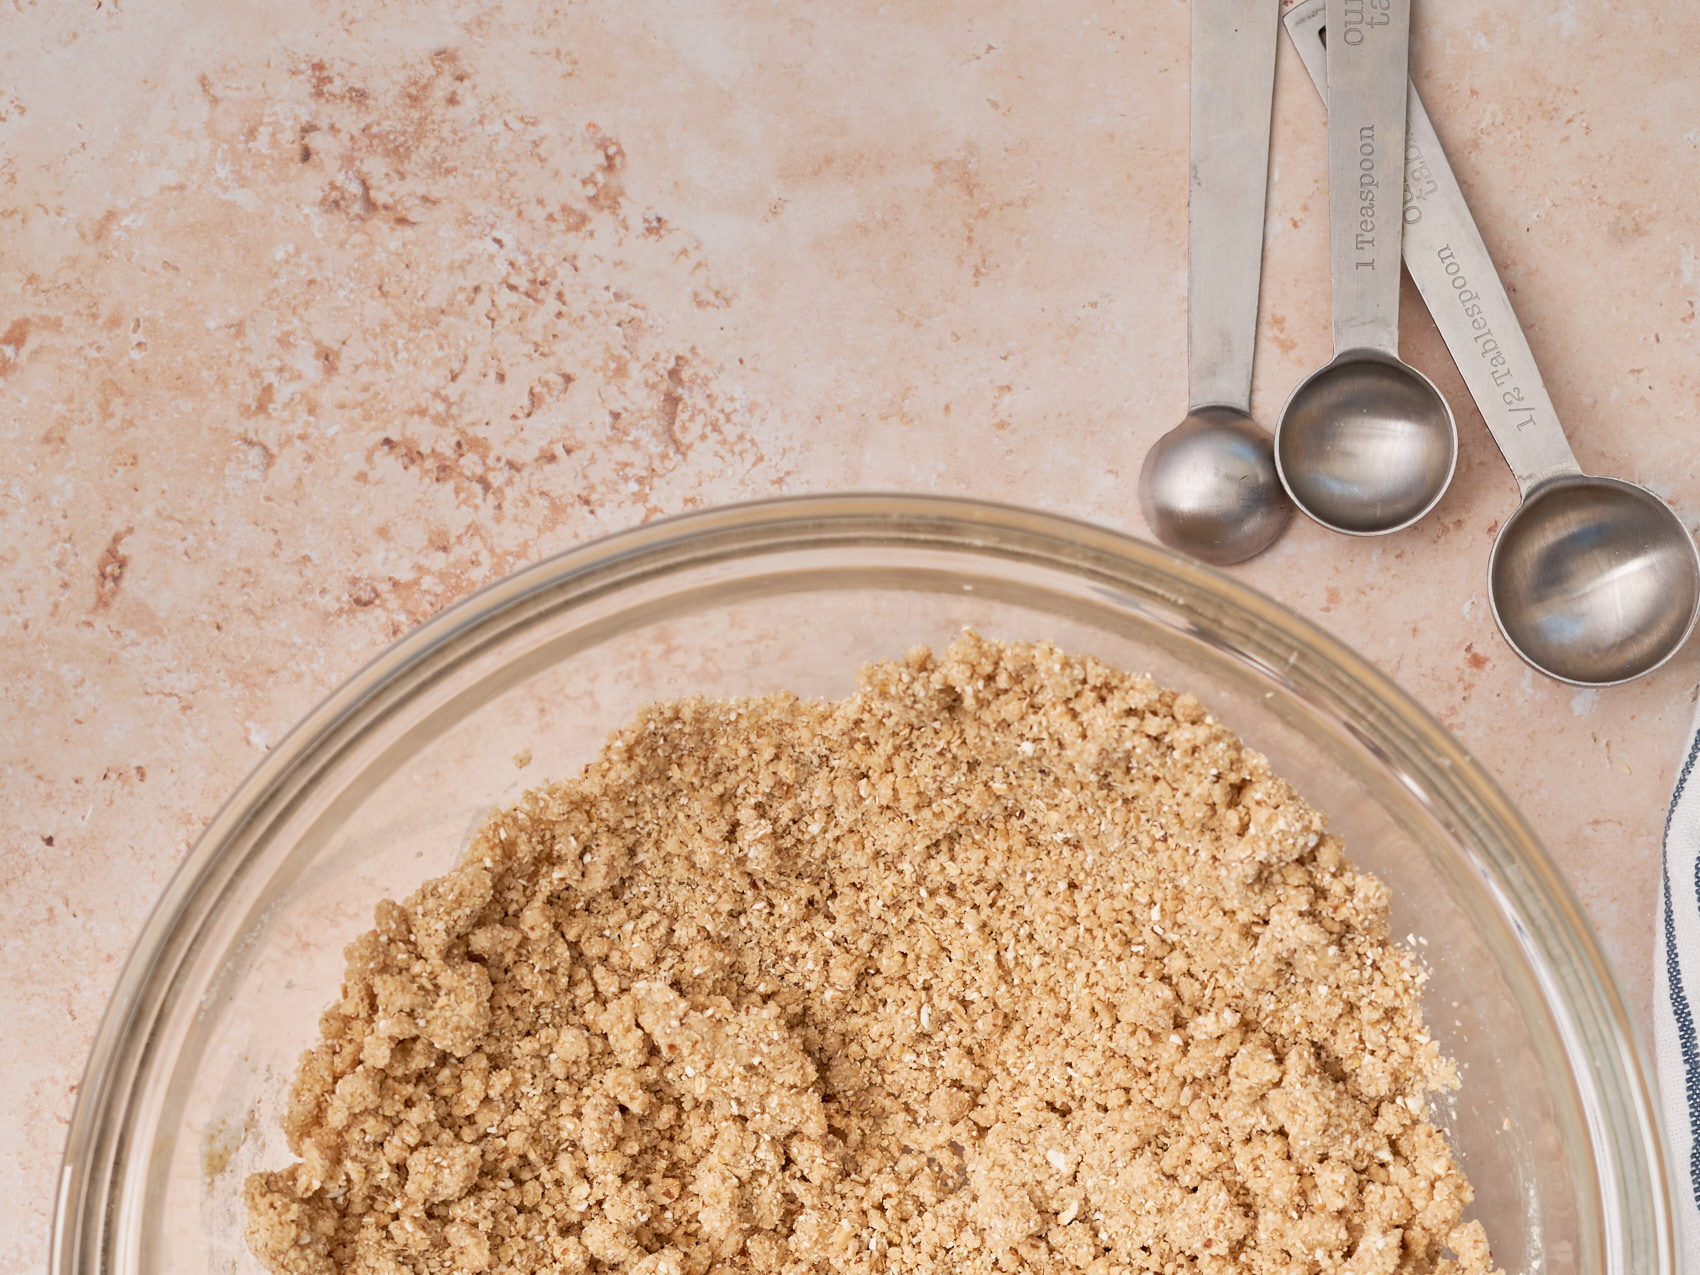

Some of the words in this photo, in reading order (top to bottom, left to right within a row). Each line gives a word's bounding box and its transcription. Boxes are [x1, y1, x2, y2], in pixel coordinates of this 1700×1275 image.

[1355, 124, 1379, 250] Teaspoon
[1355, 258, 1375, 271] 1
[1436, 243, 1512, 387] Tablespoon
[1502, 386, 1537, 432] 1/2
